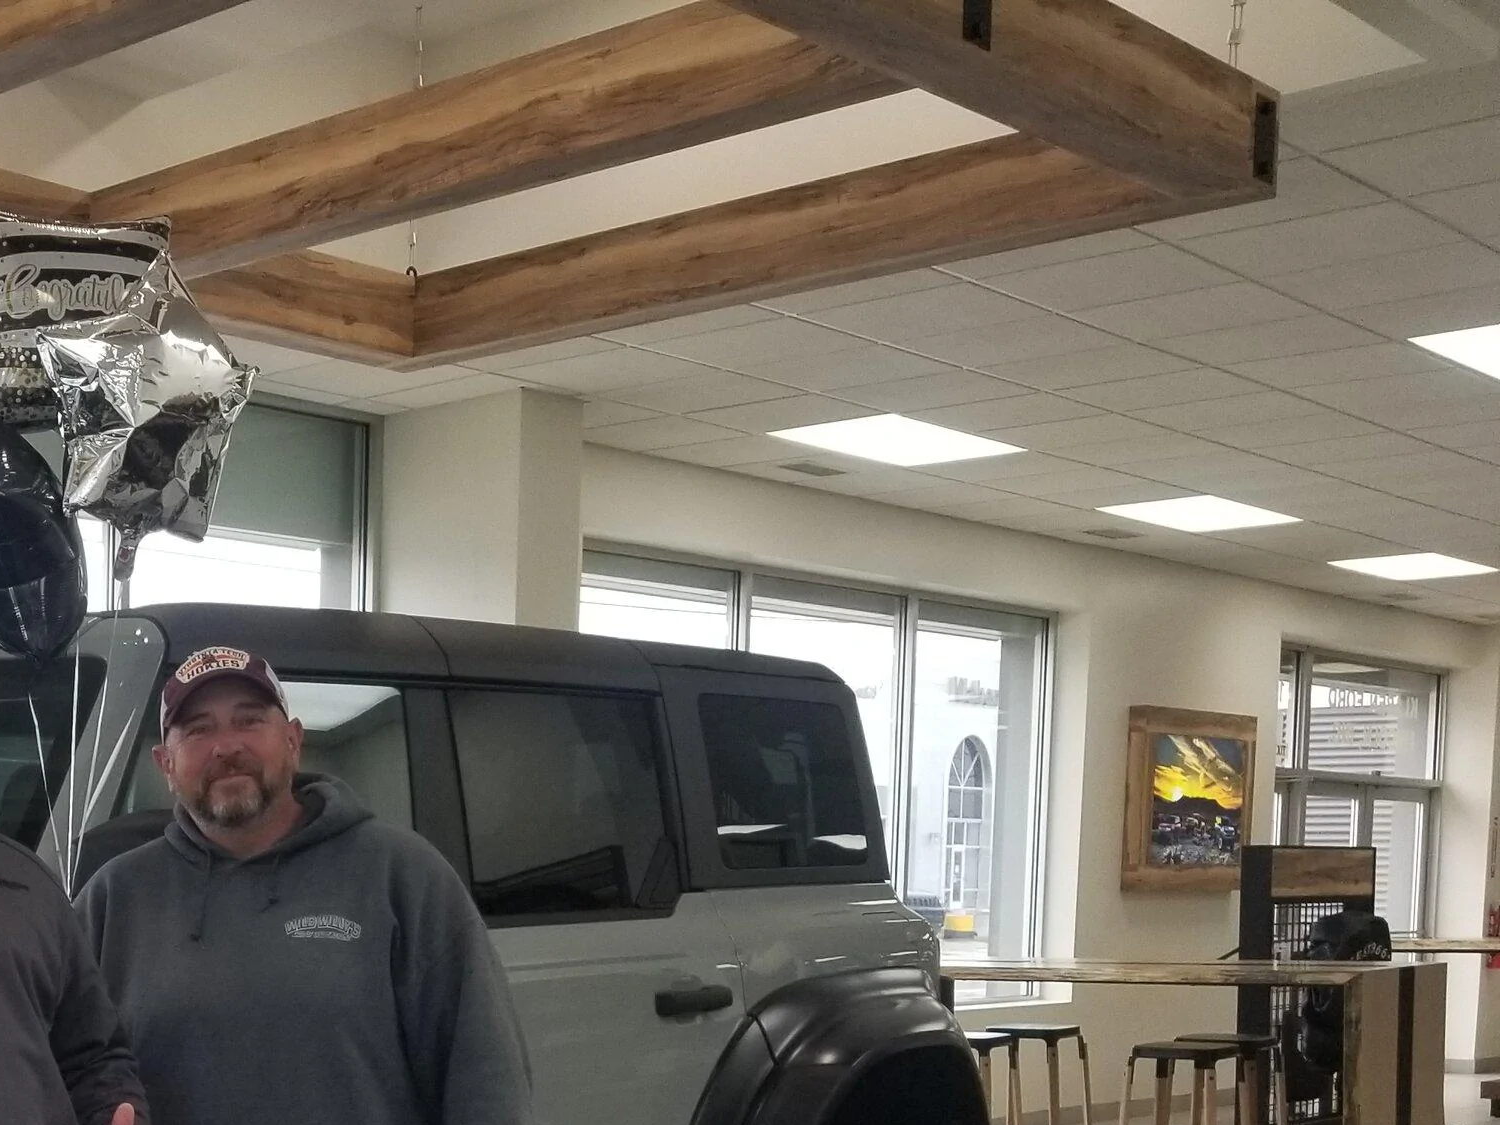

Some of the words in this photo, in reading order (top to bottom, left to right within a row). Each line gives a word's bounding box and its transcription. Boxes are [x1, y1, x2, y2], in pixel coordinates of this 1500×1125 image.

[179, 648, 218, 675] VIRGINIA
[222, 648, 245, 660] TECH
[186, 659, 240, 679] HOKIES
[284, 916, 317, 935] WILD
